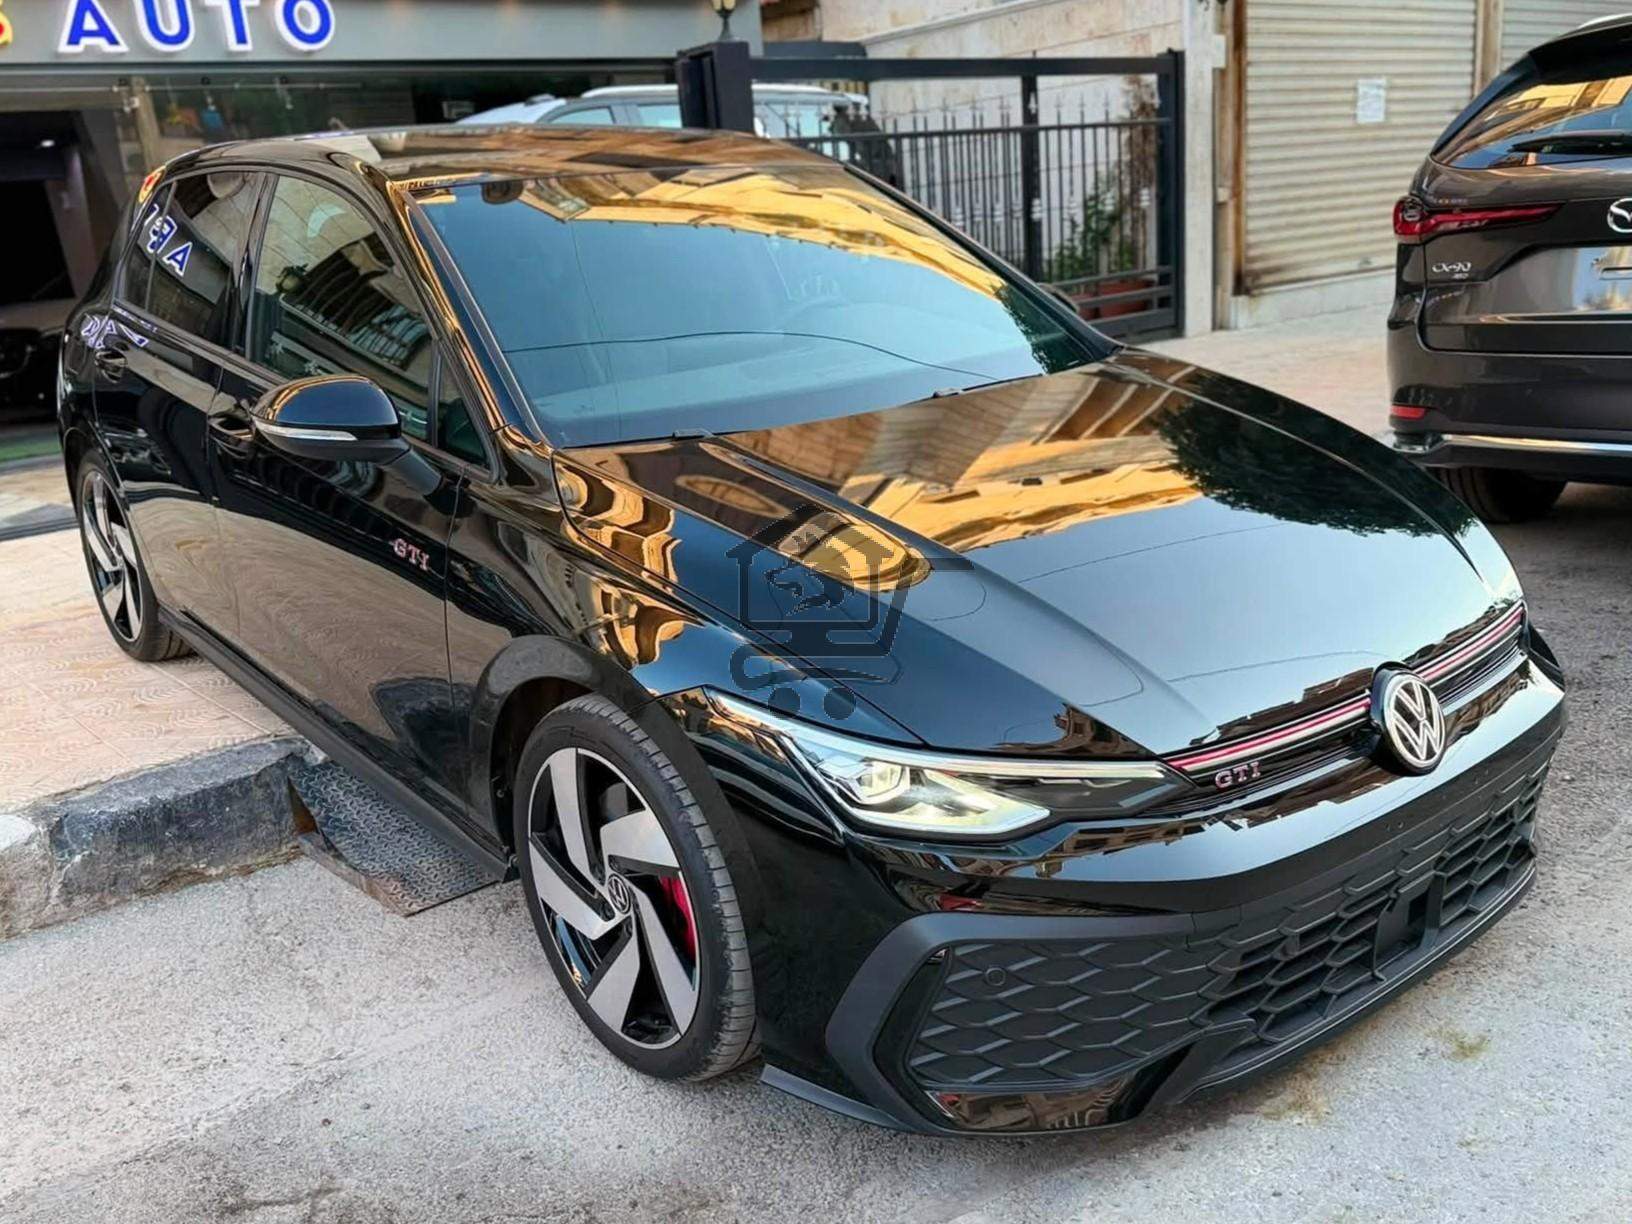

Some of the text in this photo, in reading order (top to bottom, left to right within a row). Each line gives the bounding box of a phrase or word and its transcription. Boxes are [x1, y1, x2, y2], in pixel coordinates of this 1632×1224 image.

[58, 0, 336, 53] AUTO
[393, 538, 430, 571] GTI
[1215, 761, 1261, 788] GTI
